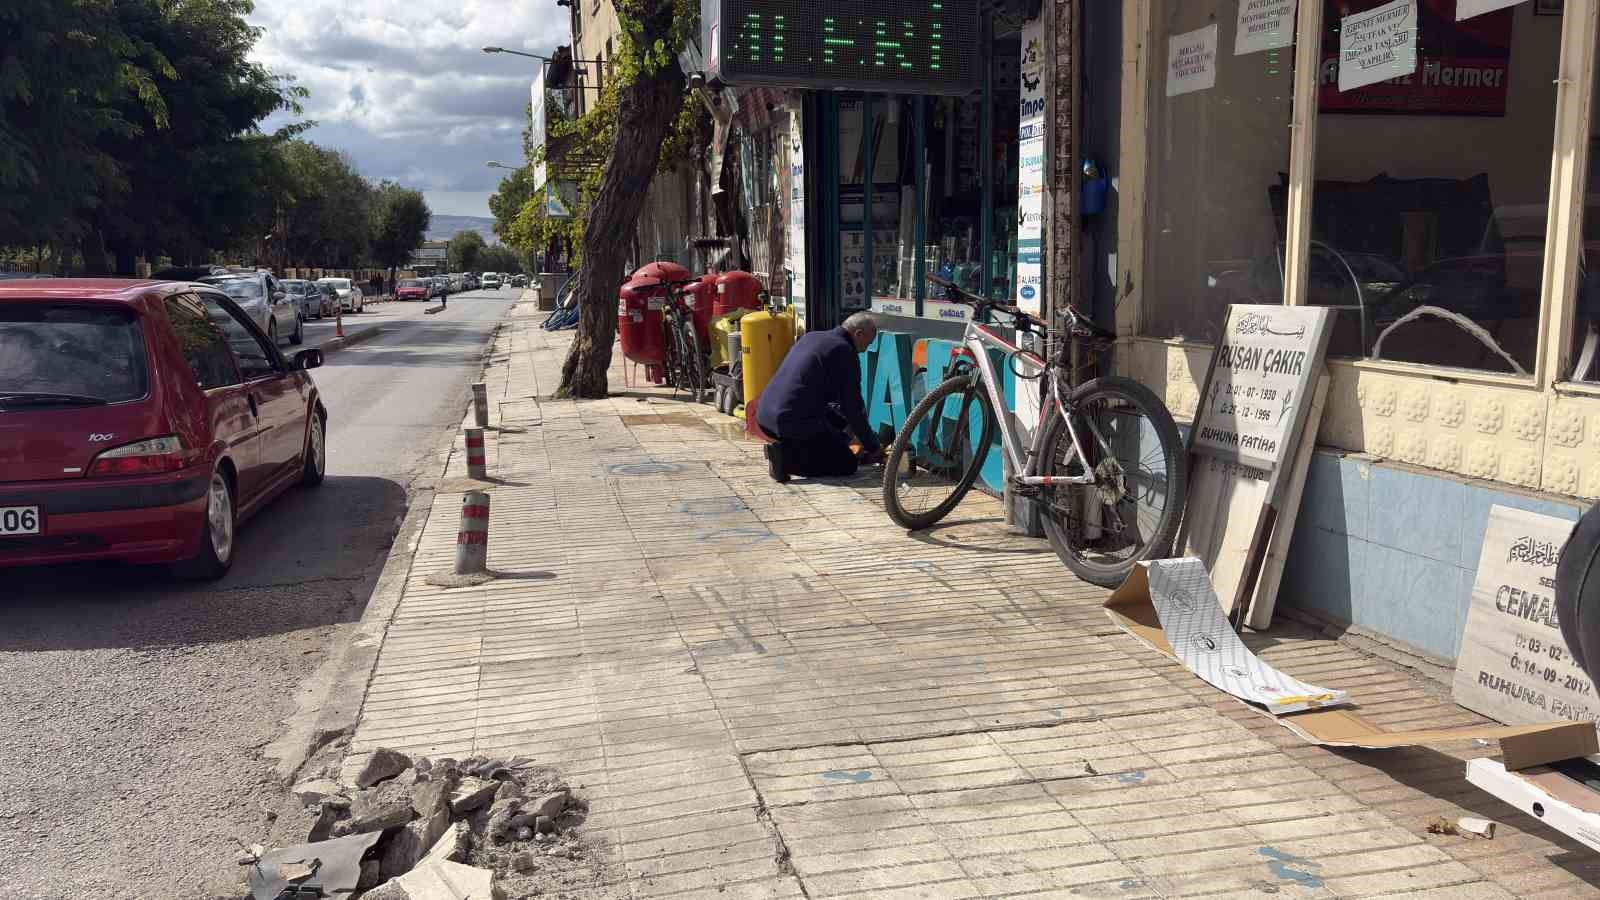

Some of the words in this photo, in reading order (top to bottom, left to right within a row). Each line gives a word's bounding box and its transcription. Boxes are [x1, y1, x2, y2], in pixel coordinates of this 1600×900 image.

[1422, 60, 1504, 89] Mermer
[1218, 342, 1261, 374] RÜŞAN
[1263, 347, 1306, 378] ÇAKIR
[88, 433, 114, 441] 106
[1201, 427, 1238, 445] RUHUNA
[1549, 645, 1562, 661] 02
[1478, 670, 1547, 710] RUHUNA
[1564, 675, 1591, 696] 2012
